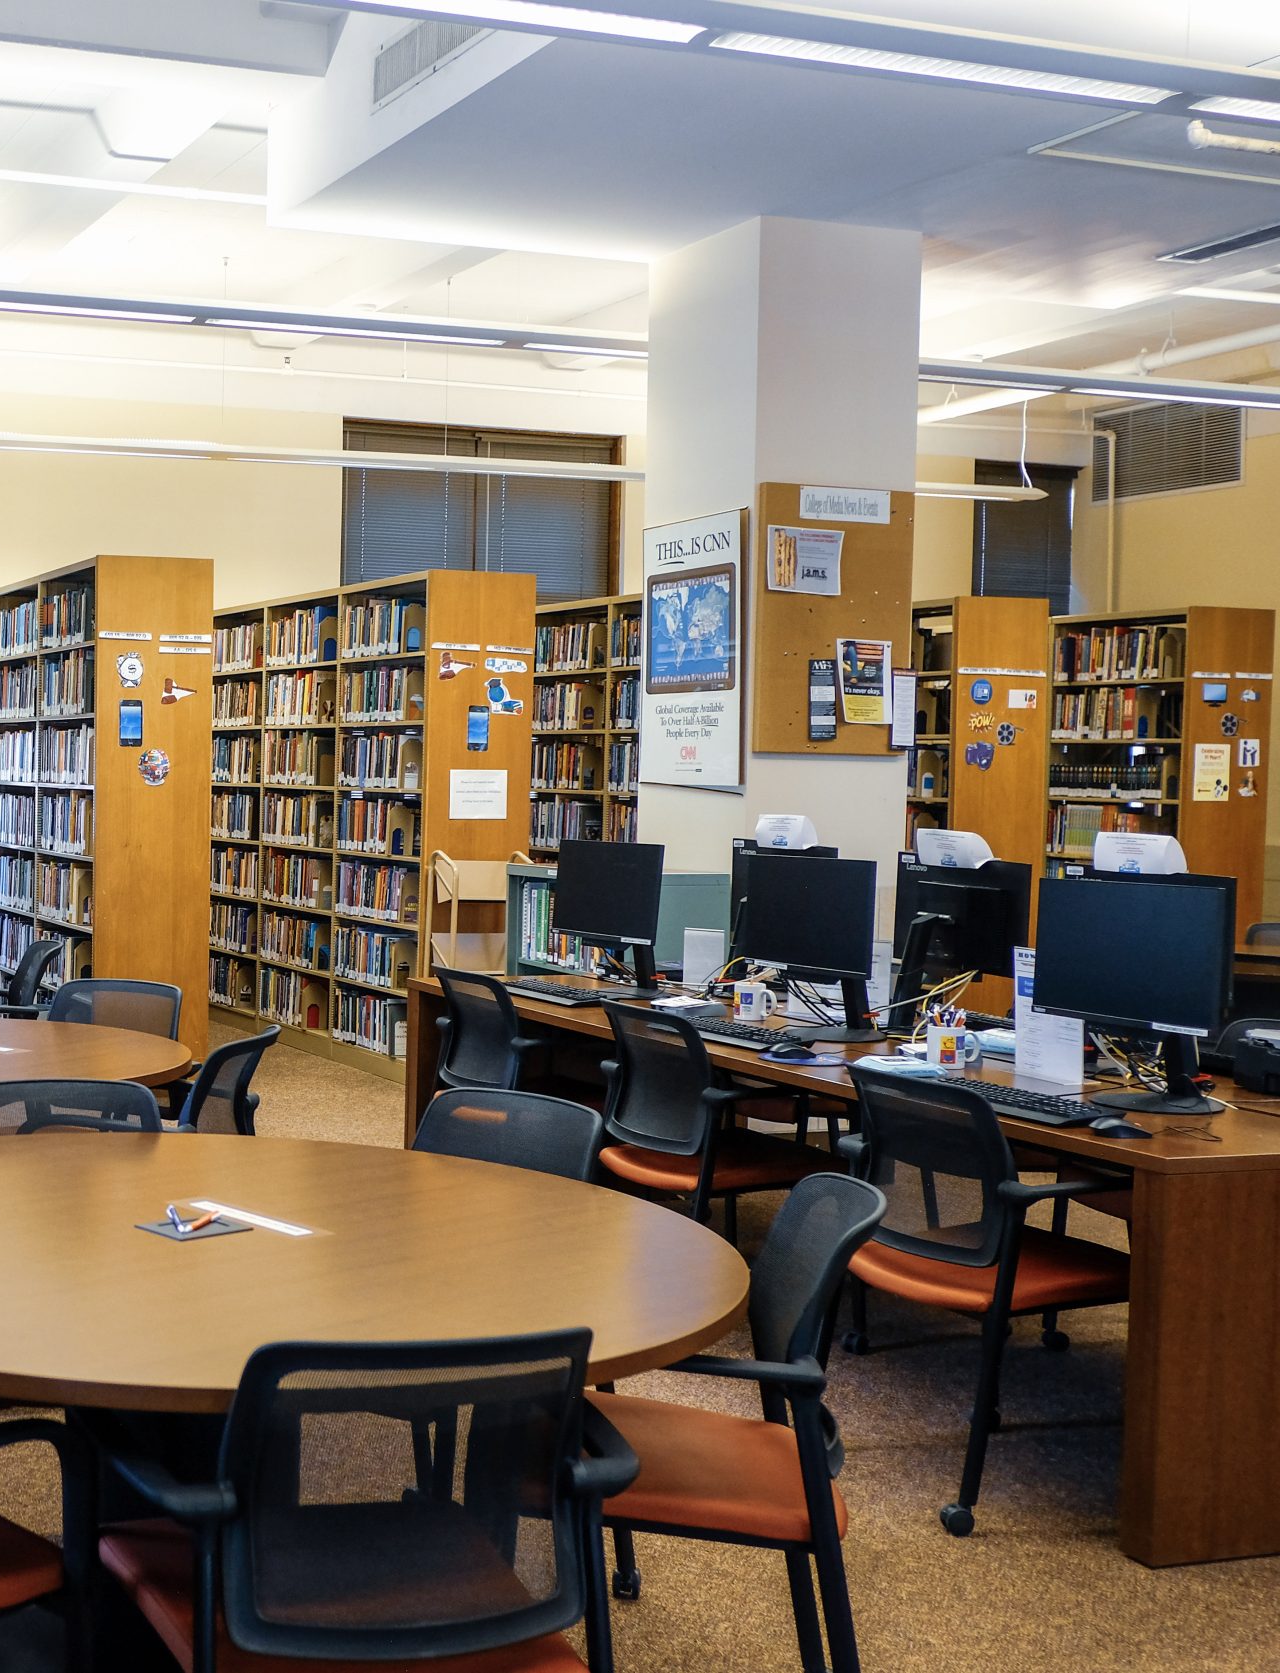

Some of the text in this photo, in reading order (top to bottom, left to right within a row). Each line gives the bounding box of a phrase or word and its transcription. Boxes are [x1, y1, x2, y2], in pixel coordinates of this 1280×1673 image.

[805, 494, 822, 518] College
[844, 496, 857, 515] News
[863, 498, 879, 517] Events
[703, 530, 731, 553] CNN
[655, 702, 724, 717] Global Coverage Available
[660, 717, 667, 726] To
[668, 716, 682, 726] Over
[970, 712, 995, 731] POW!
[666, 728, 712, 740] People Every Day
[680, 745, 697, 760] CNN
[739, 848, 757, 856] Lenovo
[906, 863, 928, 872] Lenovo
